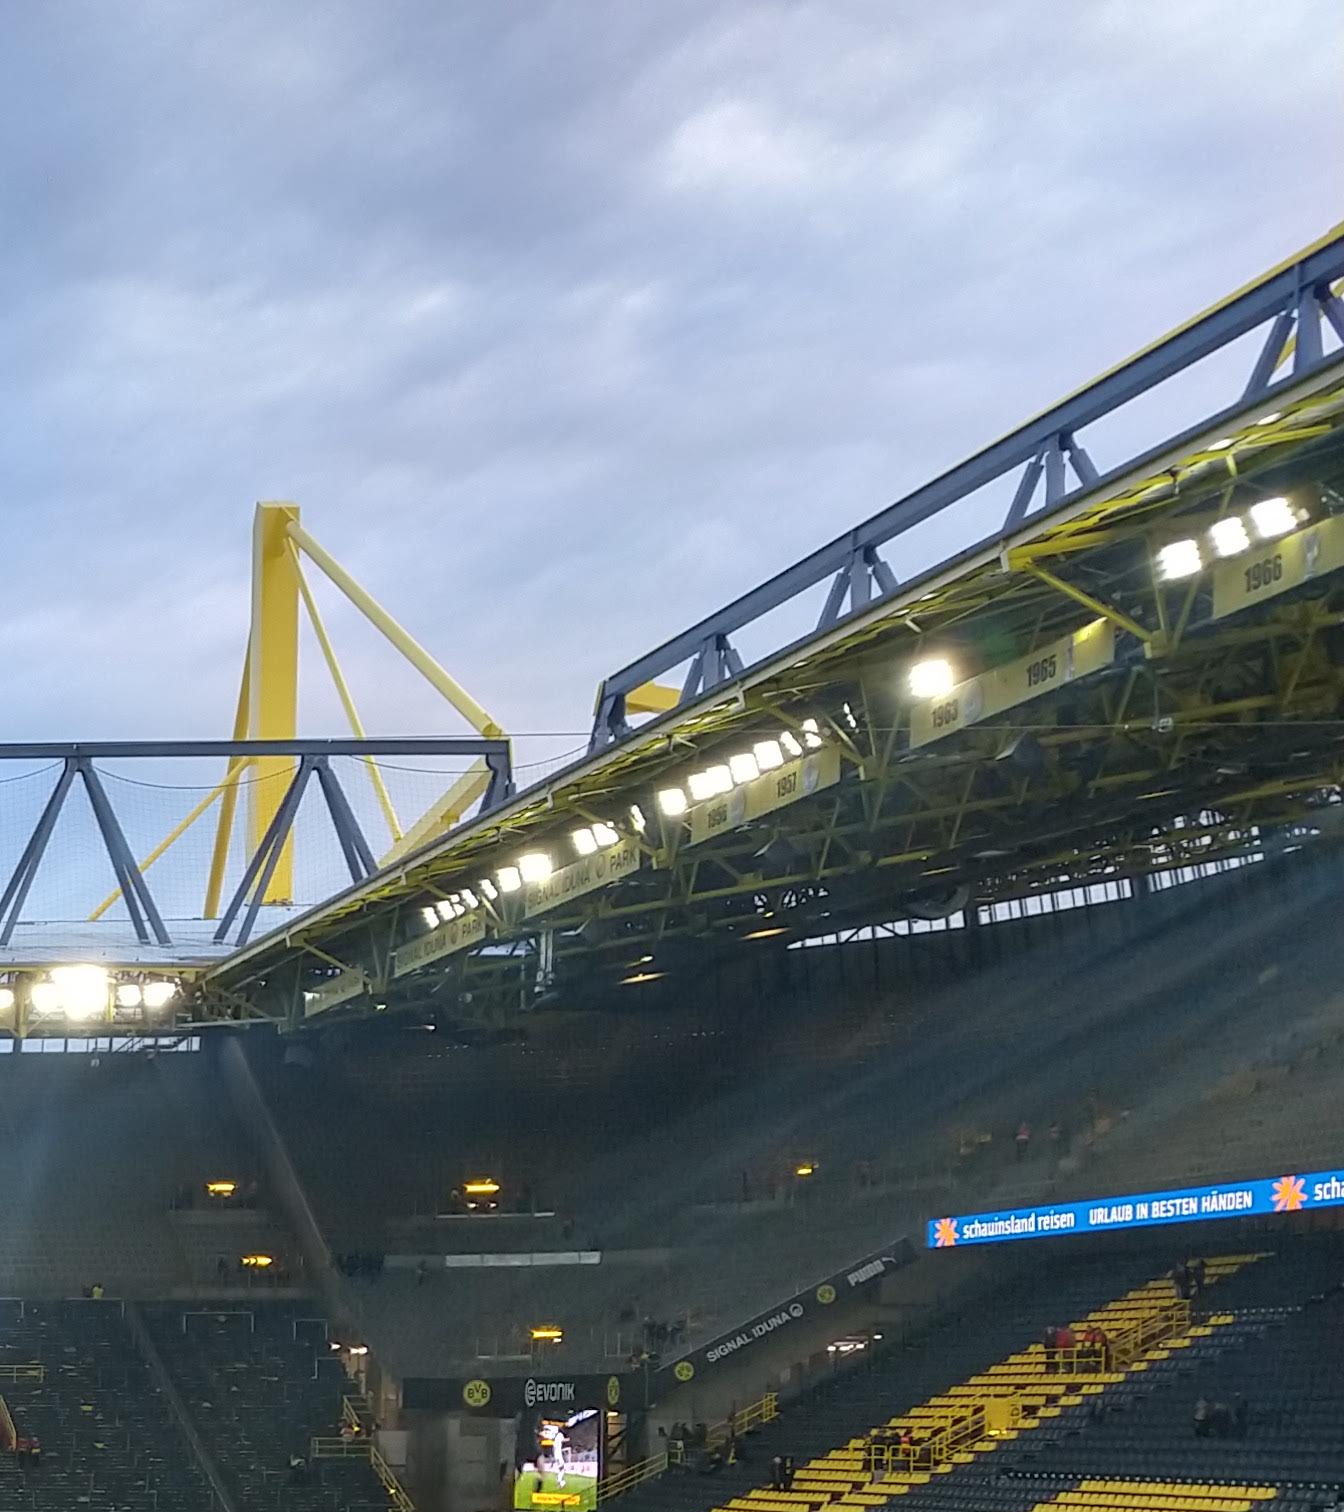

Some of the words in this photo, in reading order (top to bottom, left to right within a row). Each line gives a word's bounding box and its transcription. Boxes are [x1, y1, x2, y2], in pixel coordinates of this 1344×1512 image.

[1244, 553, 1282, 593] 1966
[1026, 654, 1056, 687] 1965
[931, 699, 959, 728] 1963
[609, 848, 637, 872] PARK
[962, 1213, 1035, 1240] schauinsland
[1038, 1209, 1075, 1230] reisen
[1089, 1205, 1133, 1226] URLAUB
[1136, 1203, 1148, 1220] IN
[1151, 1198, 1198, 1218] BESTEN
[1201, 1190, 1252, 1214] HÄNDEN
[707, 1332, 753, 1362] SIGNAL
[752, 1311, 791, 1338] IDUNA
